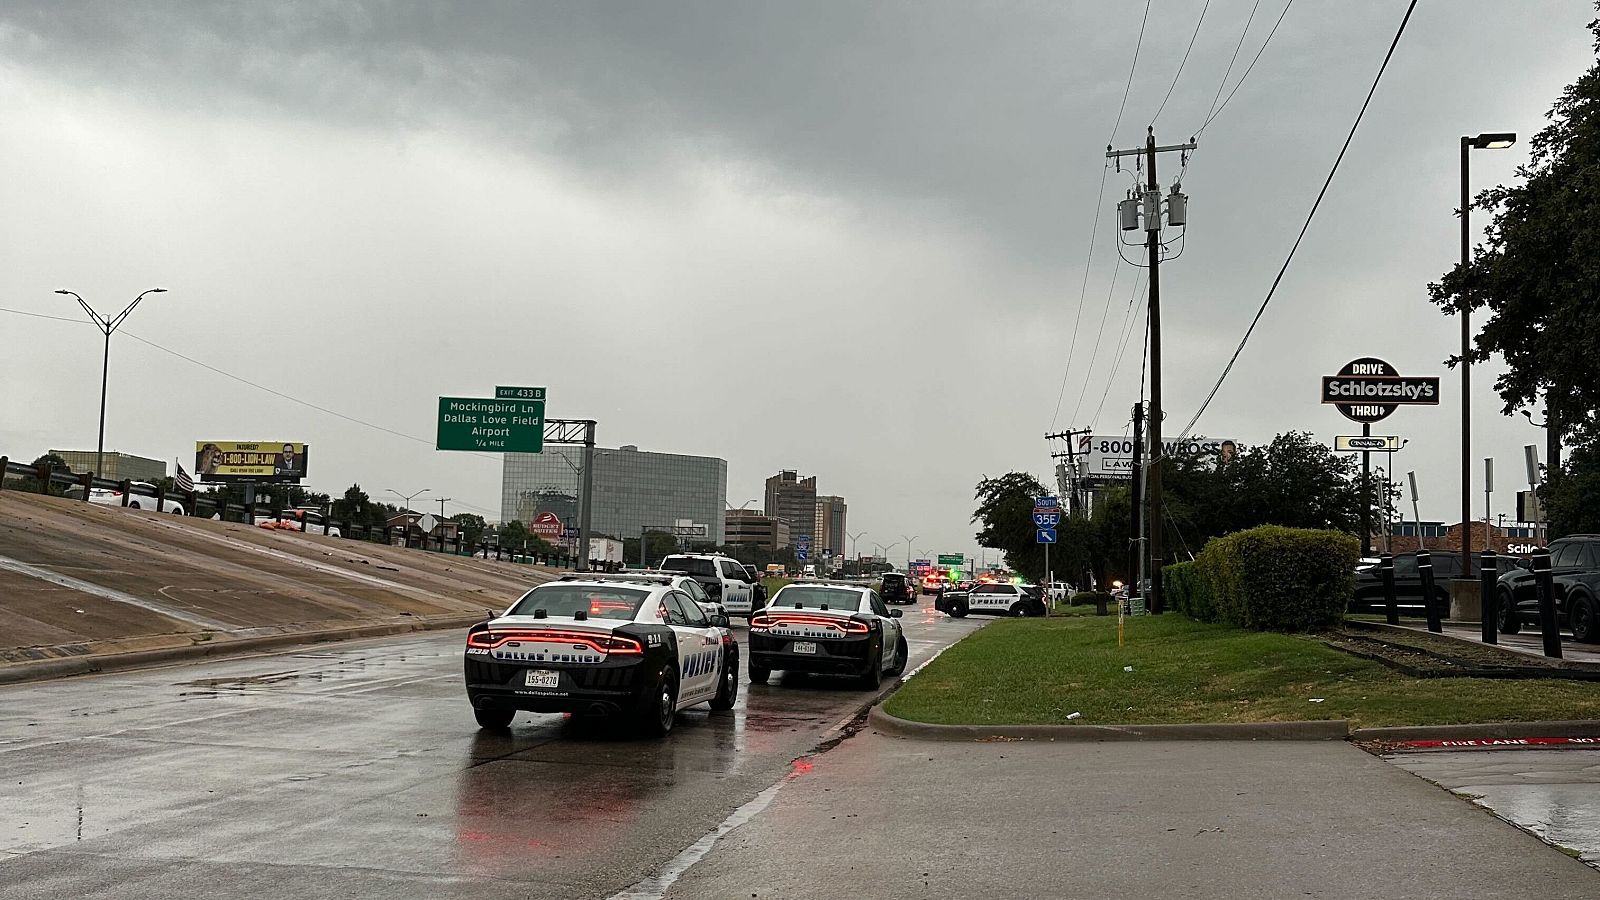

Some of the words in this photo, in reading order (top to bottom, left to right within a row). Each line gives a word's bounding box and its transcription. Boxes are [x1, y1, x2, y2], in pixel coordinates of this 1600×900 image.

[1352, 363, 1384, 375] DRIVE
[1329, 381, 1434, 400] Schlotzsky's
[450, 402, 516, 413] Mockingbird
[522, 405, 534, 413] Ln
[1350, 405, 1379, 416] THRU
[444, 414, 477, 423] Dallas
[482, 416, 507, 425] Love
[512, 416, 539, 425] Field
[472, 427, 510, 437] Airport
[1036, 514, 1057, 525] 35E
[496, 651, 544, 661] DALLAS
[552, 653, 600, 662] POLICE
[681, 650, 717, 680] POLICE
